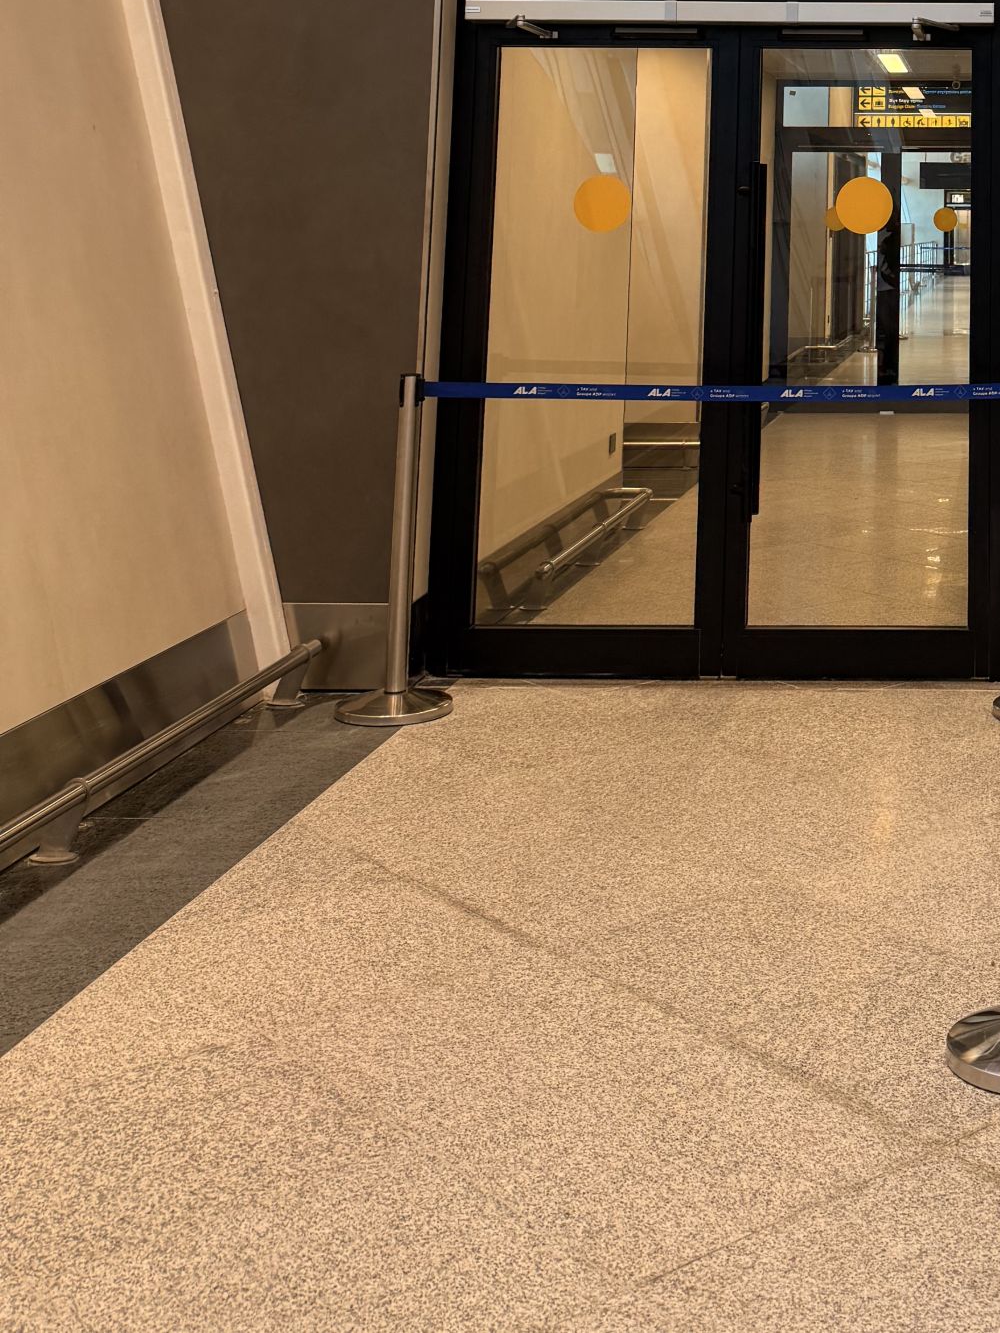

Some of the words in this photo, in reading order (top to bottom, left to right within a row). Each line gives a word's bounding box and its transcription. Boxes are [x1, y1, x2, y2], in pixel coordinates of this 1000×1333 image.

[513, 386, 537, 395] ALA
[647, 388, 671, 397] ALA
[780, 389, 804, 398] ALA
[911, 388, 935, 397] ALA
